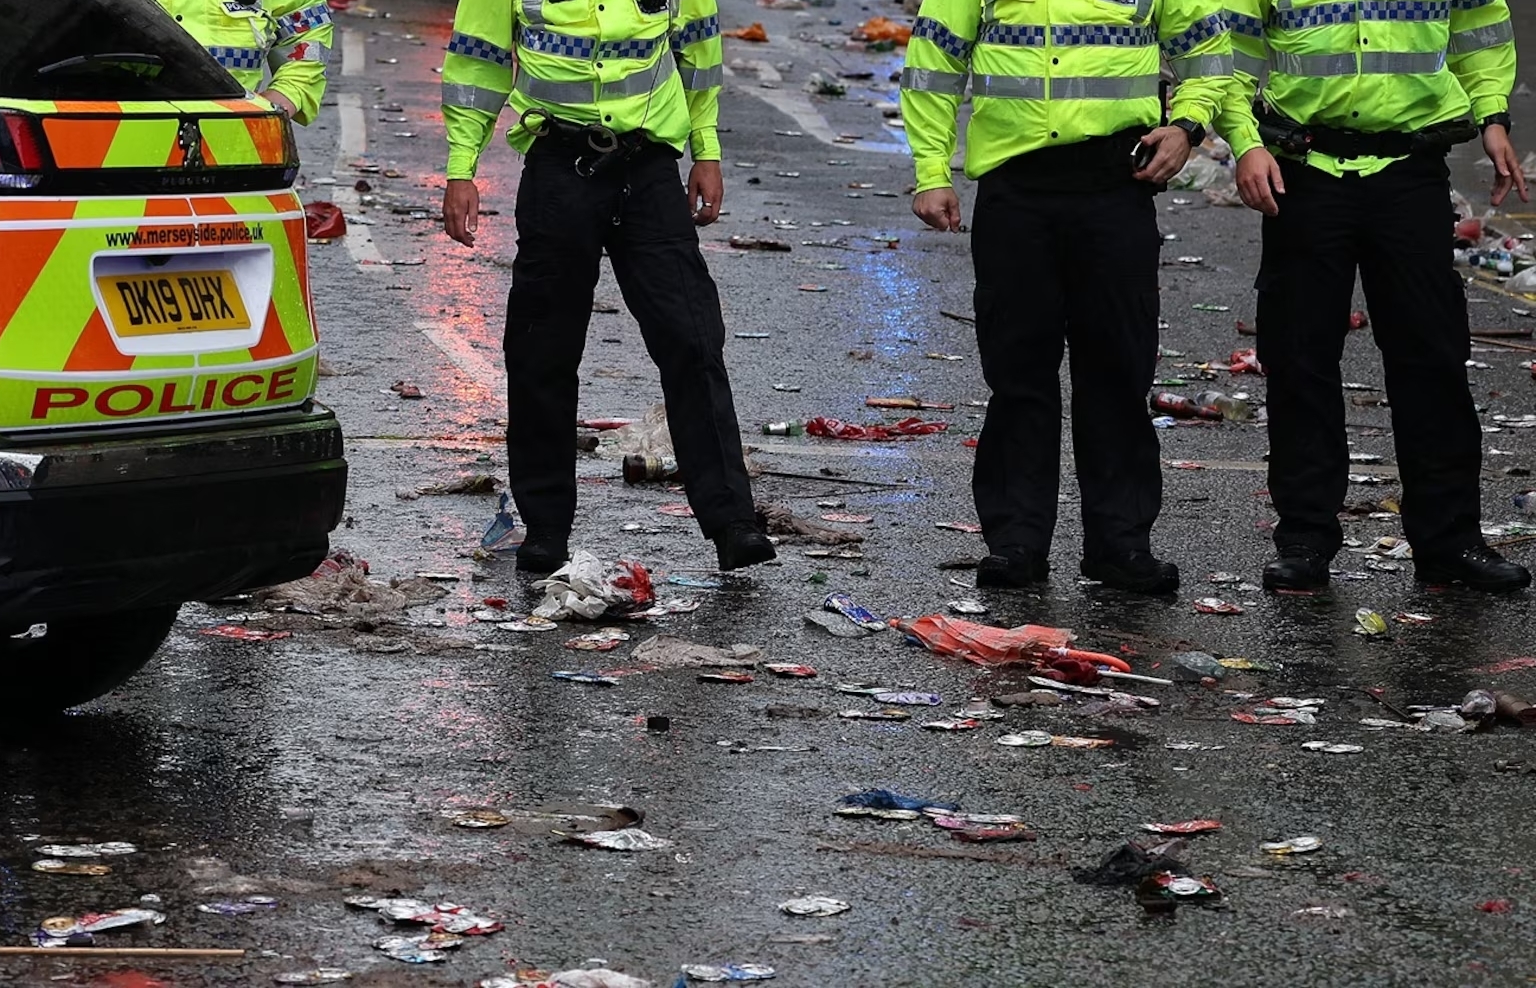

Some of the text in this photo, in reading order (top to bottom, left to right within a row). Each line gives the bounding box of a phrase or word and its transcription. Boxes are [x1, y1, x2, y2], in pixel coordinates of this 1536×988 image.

[105, 222, 264, 247] www.merseyside.police.uk
[115, 276, 235, 326] DK19 DHX
[30, 366, 299, 420] POLICE
